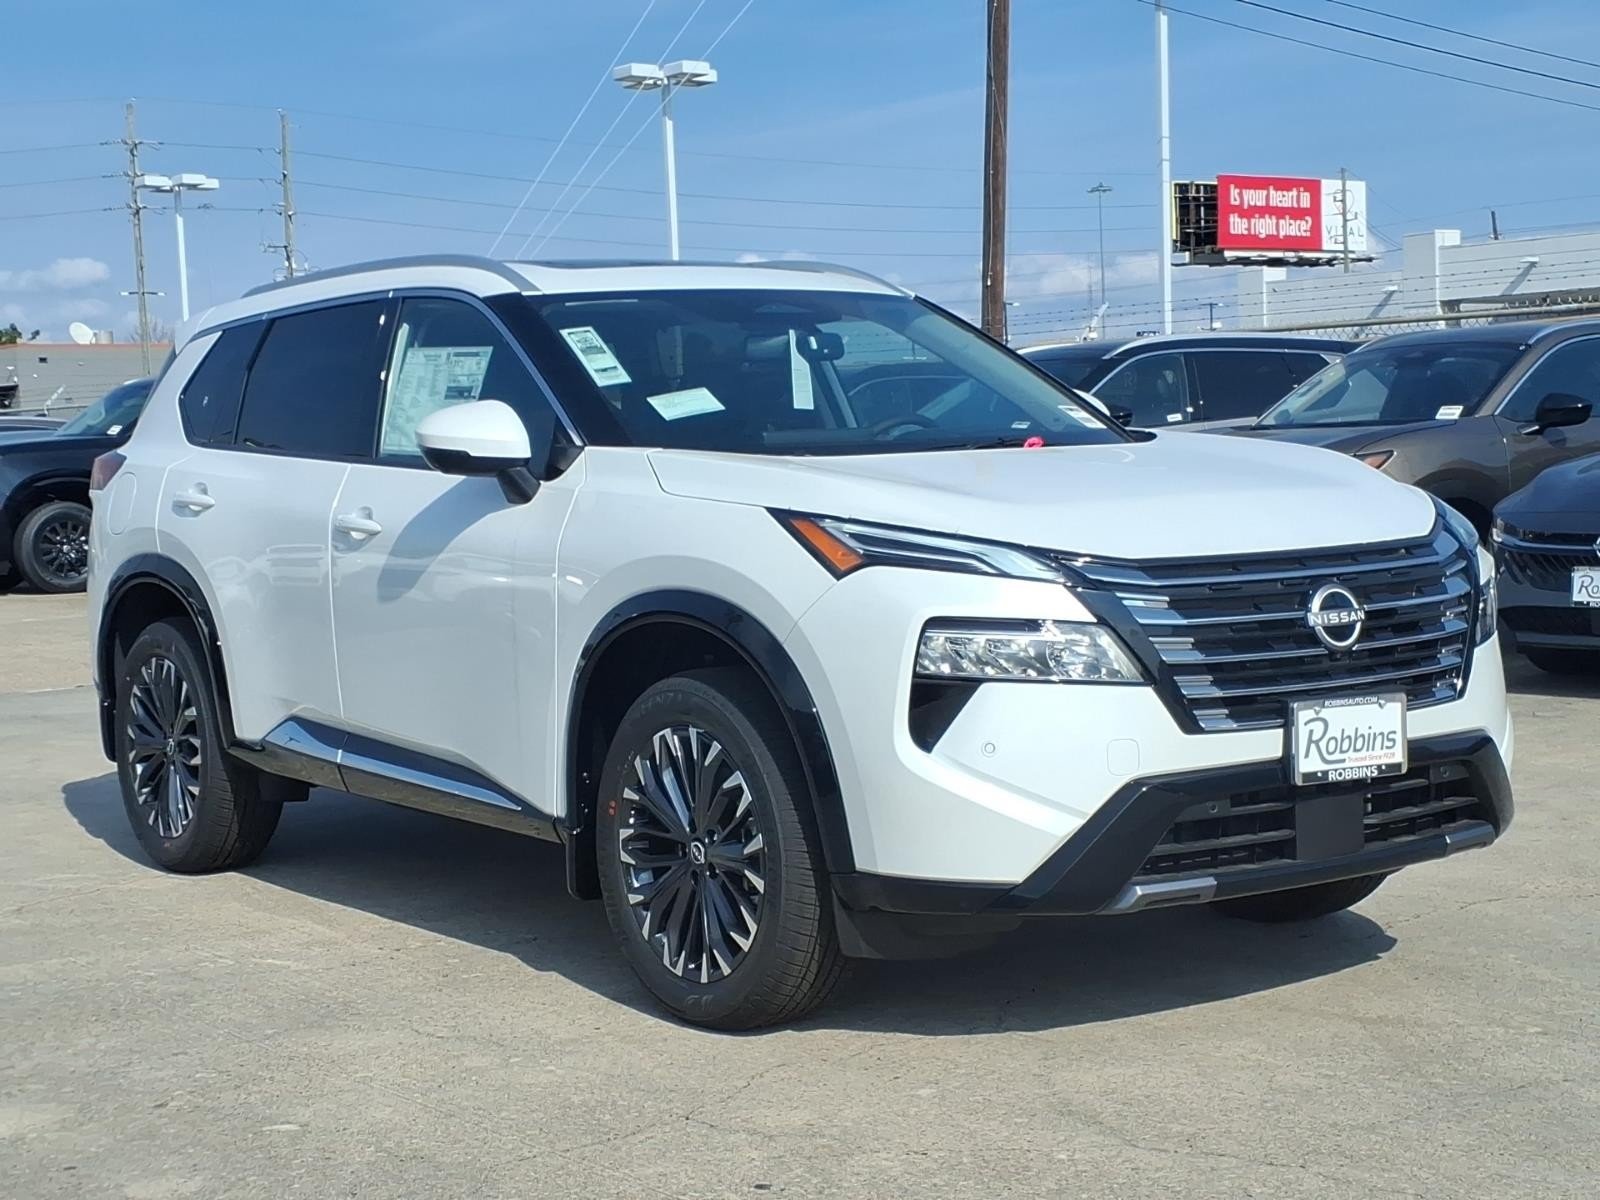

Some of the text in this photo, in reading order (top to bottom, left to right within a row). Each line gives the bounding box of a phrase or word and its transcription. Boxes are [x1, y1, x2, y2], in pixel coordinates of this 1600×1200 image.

[1230, 184, 1311, 210] Is your heart in
[1229, 213, 1312, 239] the right place?
[1325, 225, 1364, 237] VIAL
[1310, 610, 1365, 625] NISSAN
[1304, 716, 1397, 765] Robbins
[1328, 765, 1379, 782] ROBBINS
